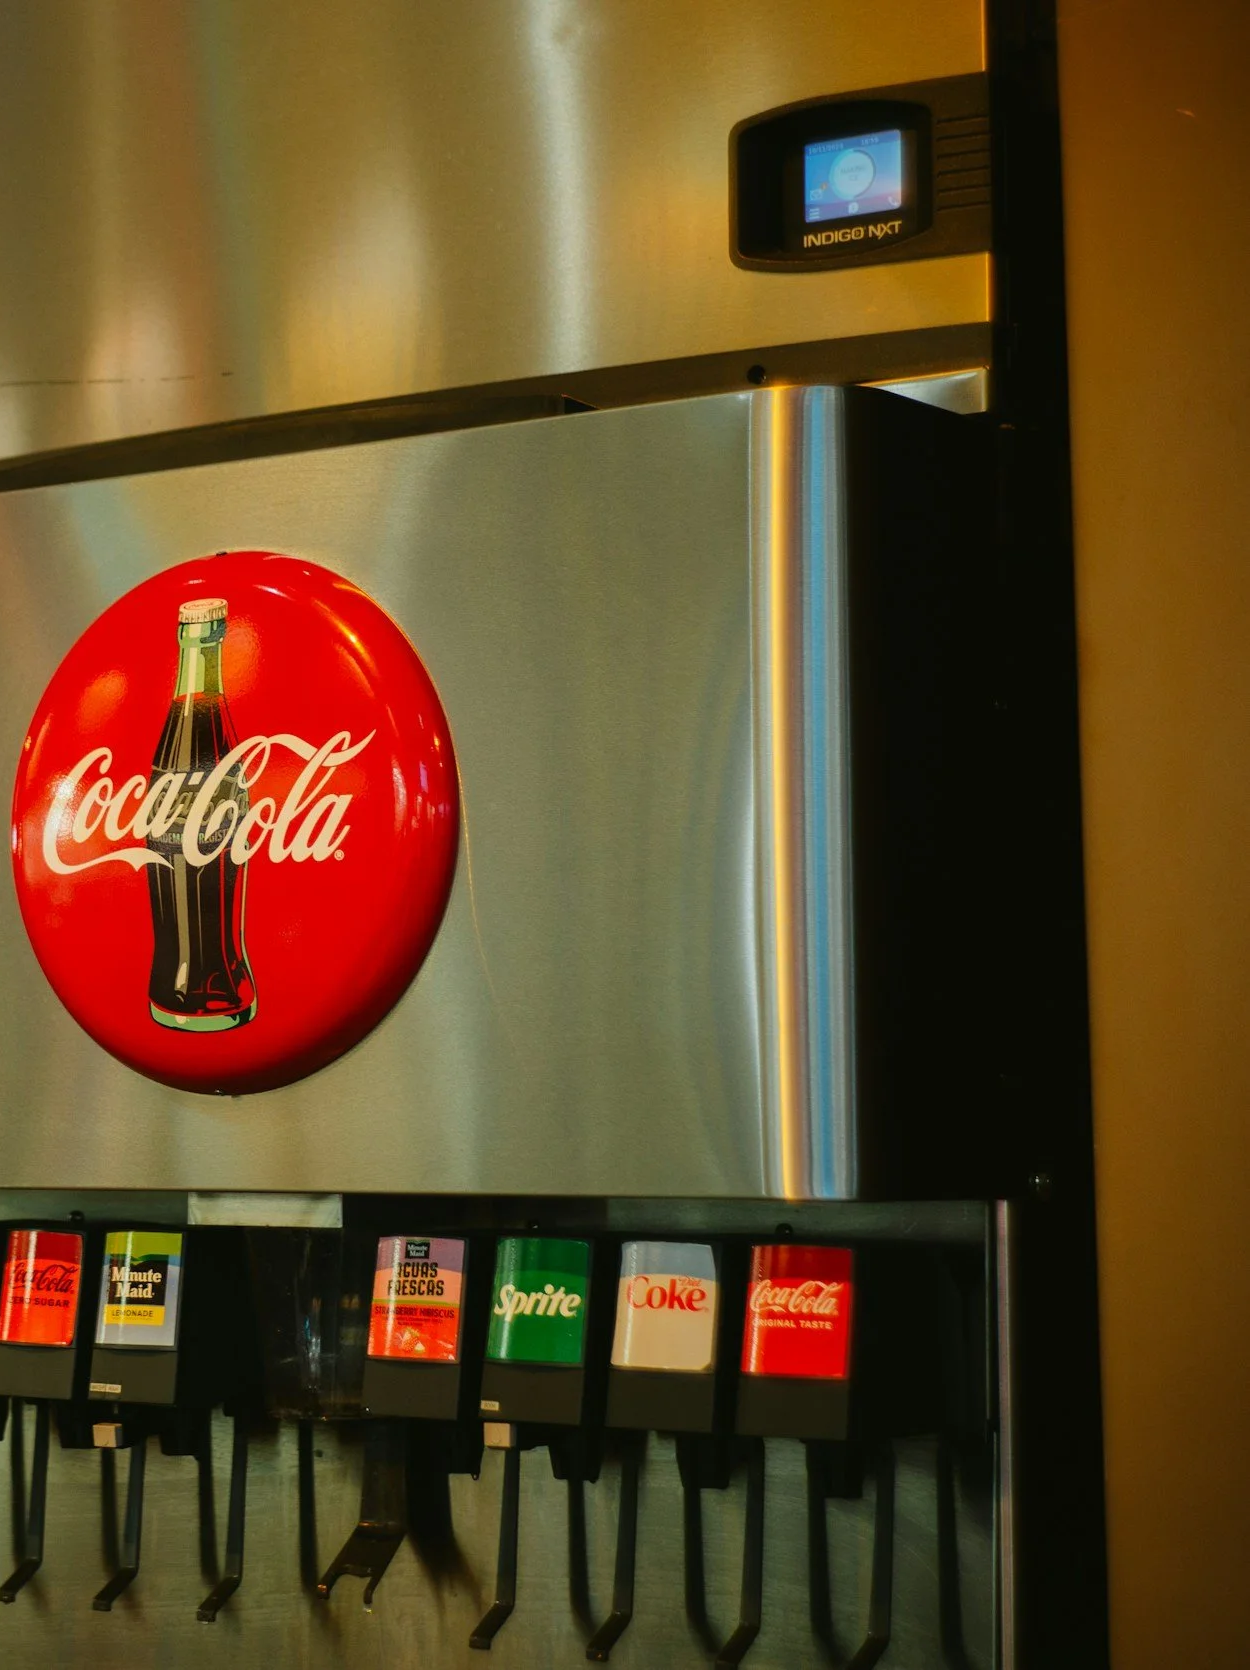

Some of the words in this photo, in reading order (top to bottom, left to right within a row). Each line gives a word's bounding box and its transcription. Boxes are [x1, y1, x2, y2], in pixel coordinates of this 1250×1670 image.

[803, 226, 864, 248] INDIGO
[868, 220, 903, 240] NXT
[42, 729, 377, 875] Coca-Cola
[34, 1297, 70, 1308] SUGAR
[115, 1282, 153, 1299] Maid
[493, 1283, 582, 1323] Sprite
[627, 1276, 707, 1312] Coke
[753, 1318, 797, 1328] RIGINAL
[799, 1320, 834, 1330] TASTE
